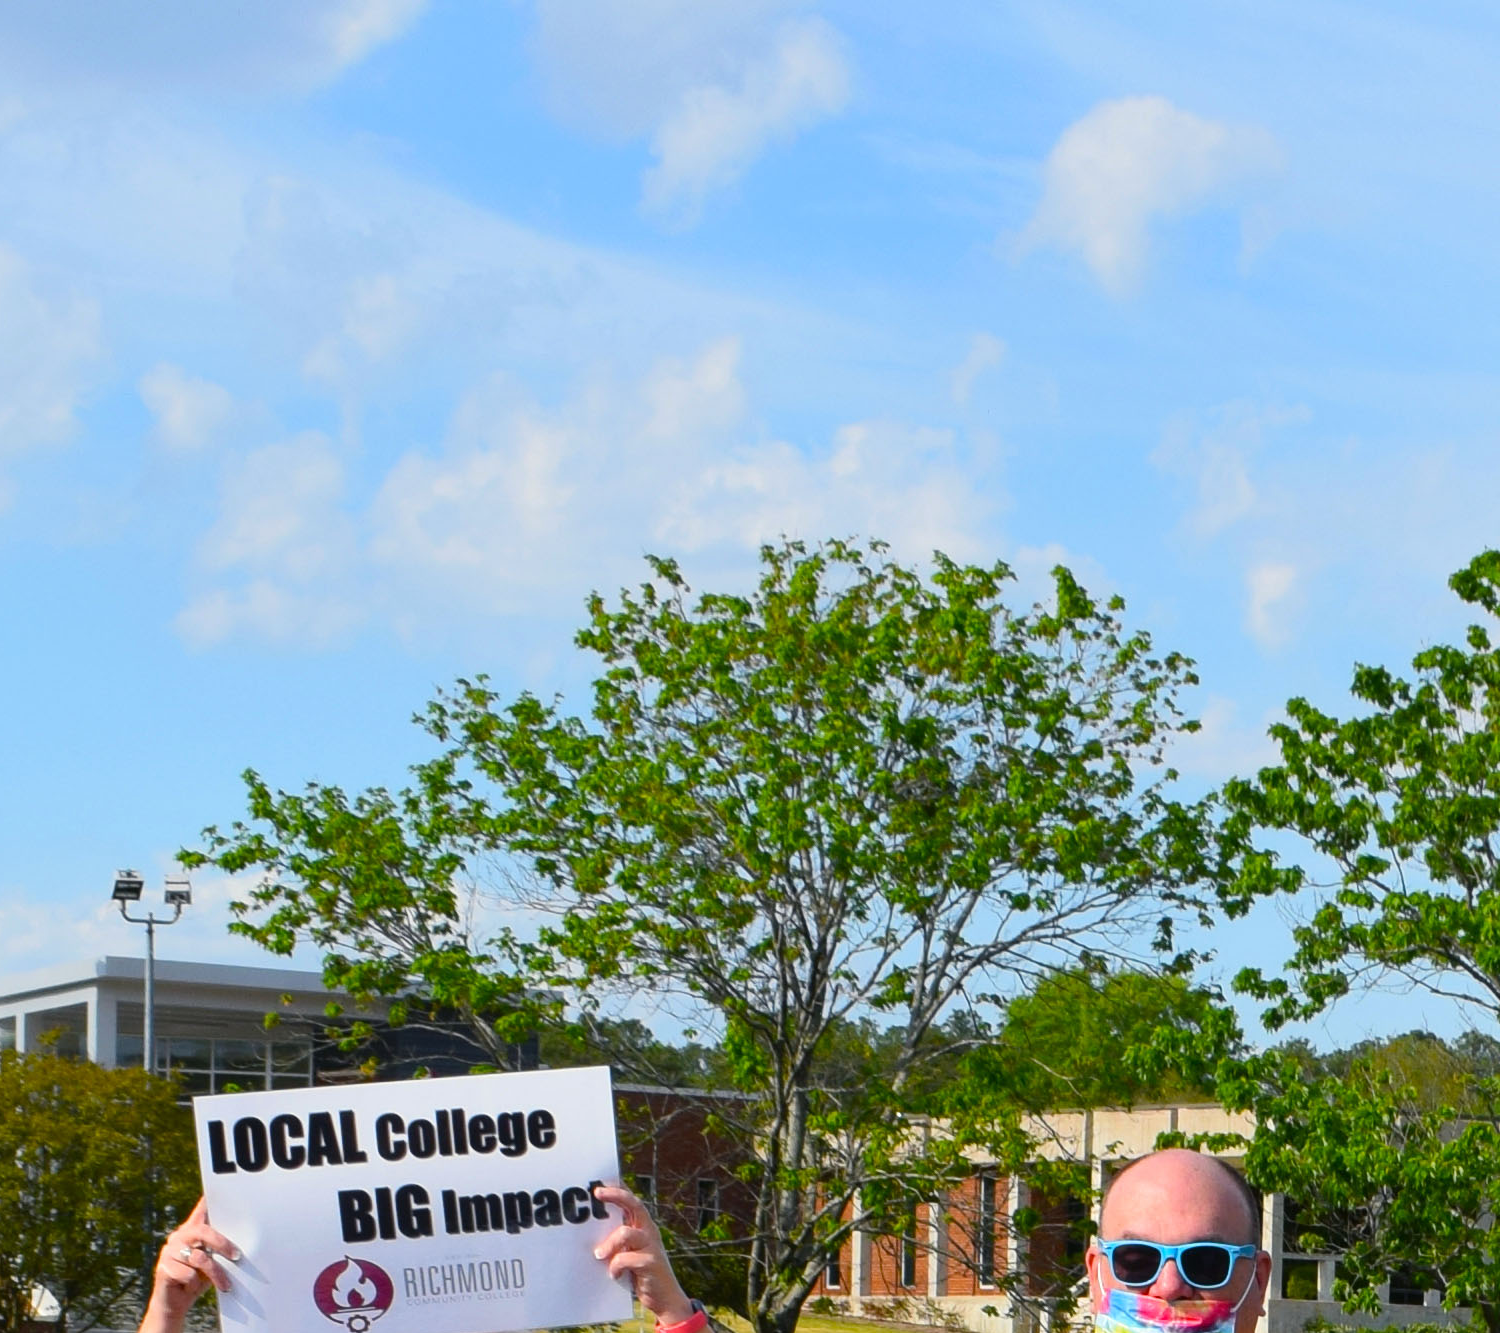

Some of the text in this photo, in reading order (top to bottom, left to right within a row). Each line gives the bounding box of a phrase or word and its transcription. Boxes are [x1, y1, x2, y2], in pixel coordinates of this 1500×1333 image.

[208, 1108, 556, 1174] LOCAL College
[338, 1179, 610, 1243] BIG Impact
[403, 1258, 525, 1298] RICHMOND
[406, 1290, 525, 1306] COMMUNITY COLLEGE
